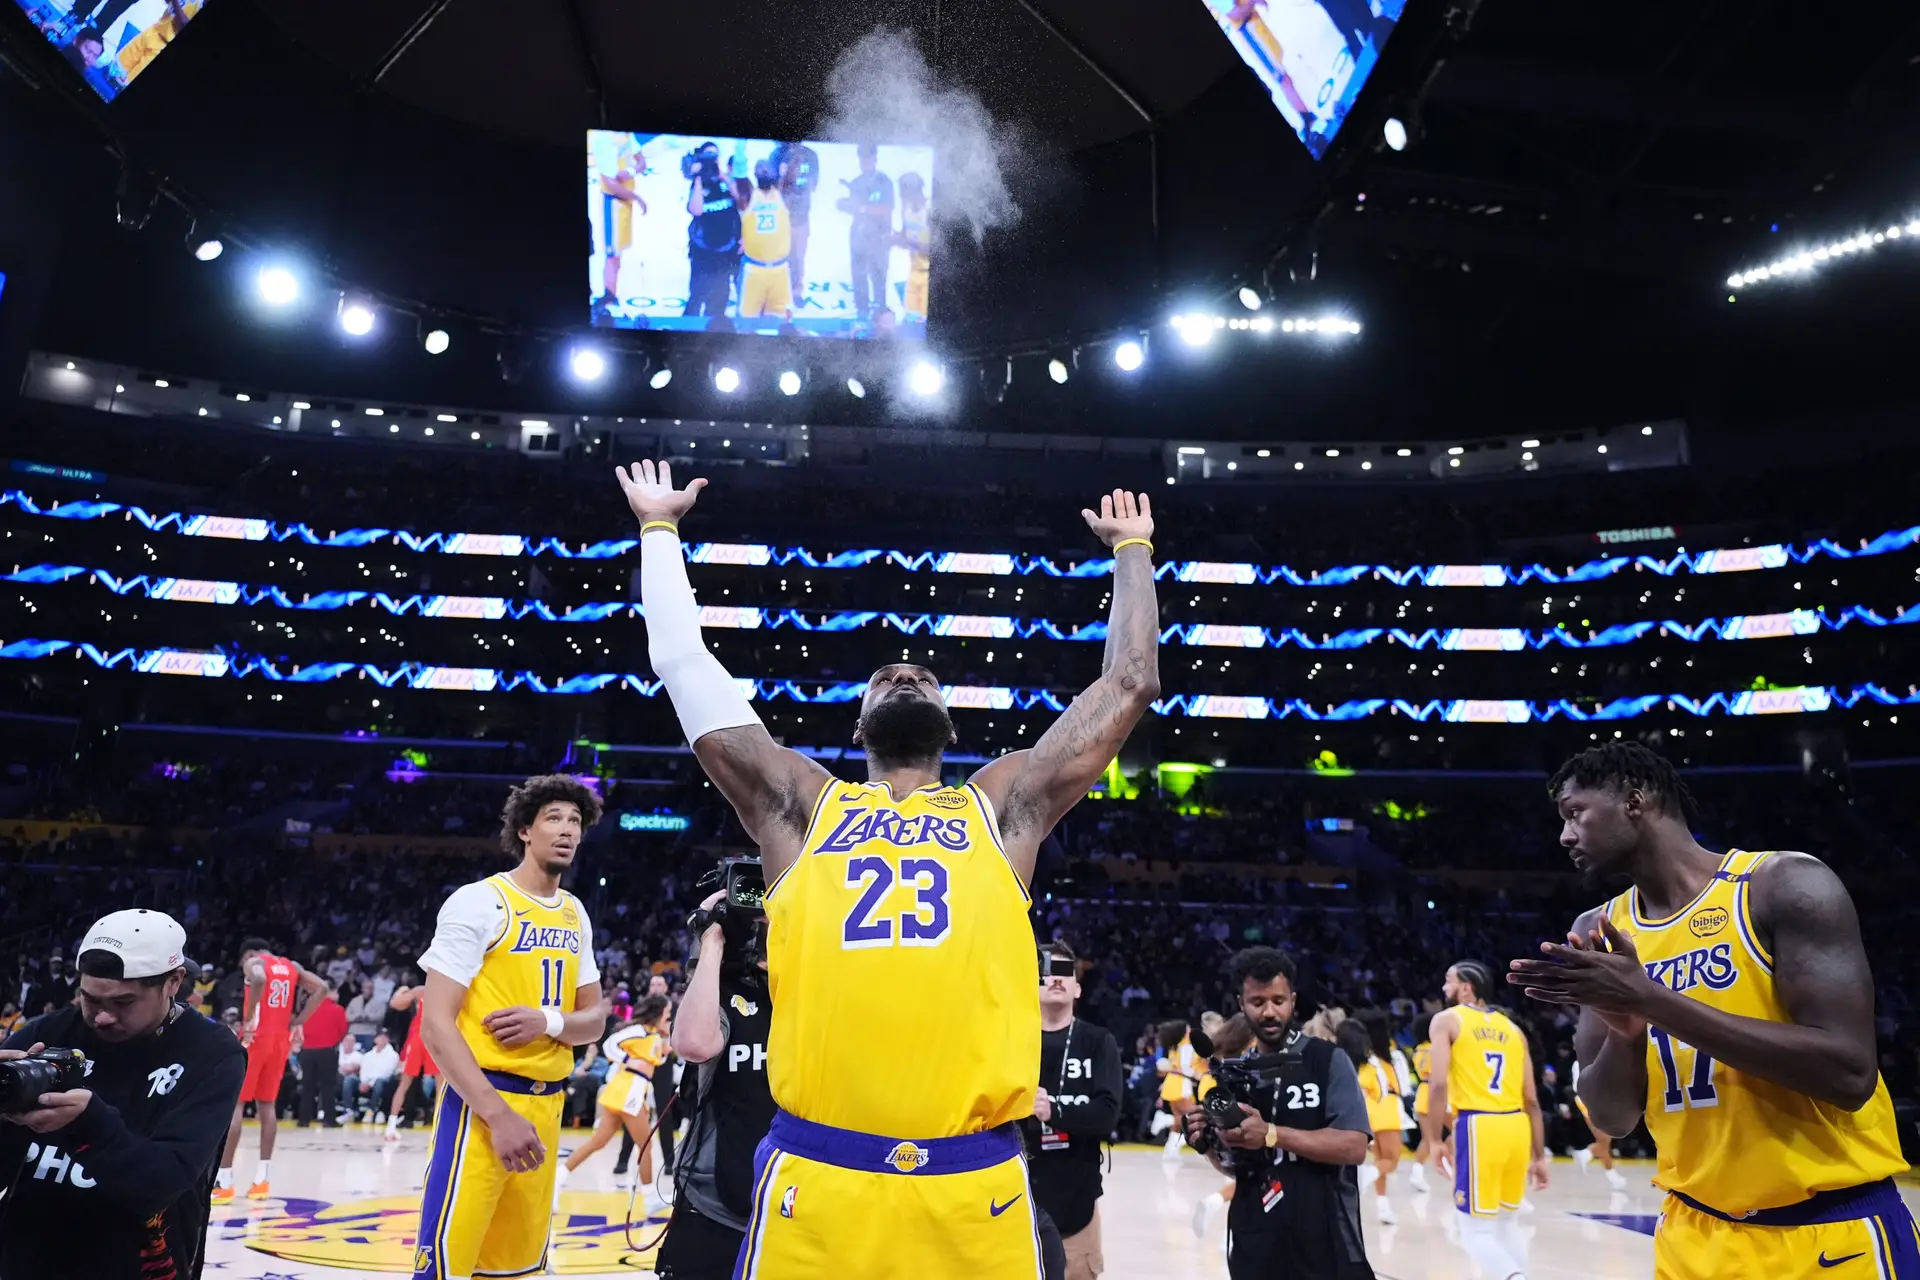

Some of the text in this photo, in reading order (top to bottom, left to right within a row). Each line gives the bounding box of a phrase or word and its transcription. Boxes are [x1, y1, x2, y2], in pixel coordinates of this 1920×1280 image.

[1596, 526, 1675, 543] TOSHIBA
[620, 813, 685, 830] Spectrum
[813, 807, 970, 855] LAKERS
[842, 856, 951, 950] 23
[1693, 914, 1726, 928] bibigo
[509, 920, 580, 955] LAKERS
[1643, 943, 1739, 992] KERS
[268, 979, 290, 1008] 21
[540, 957, 564, 1009] 11
[1066, 1058, 1092, 1079] 31
[1484, 1051, 1504, 1094] 7
[1286, 1083, 1320, 1109] 23
[887, 1148, 927, 1167] LAKERS
